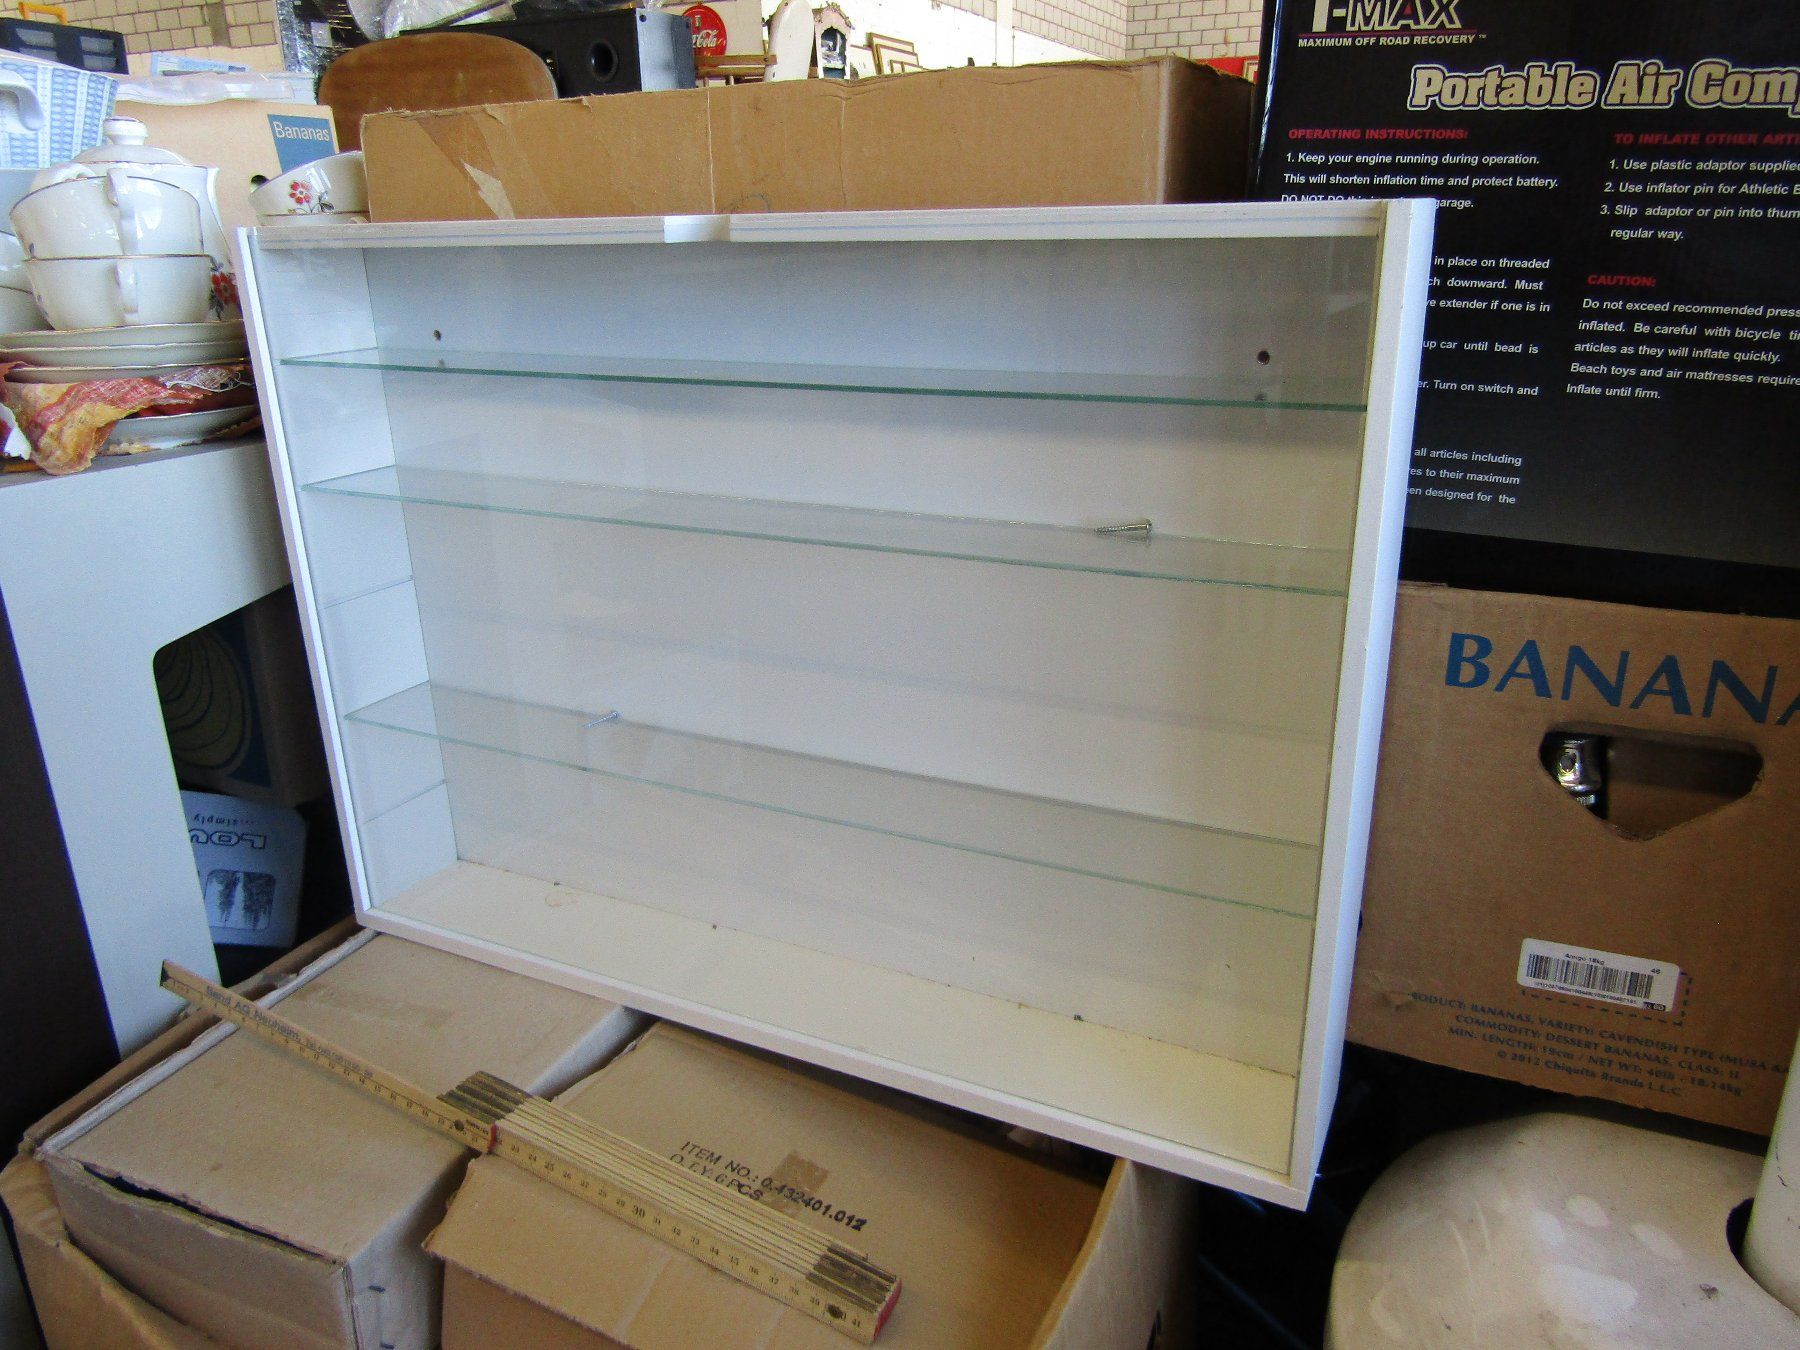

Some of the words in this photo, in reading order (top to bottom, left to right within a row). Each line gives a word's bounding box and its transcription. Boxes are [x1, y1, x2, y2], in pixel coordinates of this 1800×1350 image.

[1299, 38, 1352, 47] MAXIMUM
[1355, 37, 1377, 46] OFF
[1380, 36, 1411, 46] ROAD
[1413, 35, 1475, 45] RECOVERY
[1407, 62, 1600, 110] Portable
[1601, 59, 1684, 109] Air
[273, 121, 330, 141] Bananas
[1288, 128, 1362, 140] OPERATING
[1364, 128, 1468, 140] INSTRUCTIONS:
[1614, 132, 1635, 145] TO
[1638, 132, 1701, 145] INFLATE
[1704, 133, 1759, 145] OTHER
[1286, 152, 1295, 163] 1.
[1297, 152, 1326, 165] Keep
[1327, 154, 1354, 165] your
[1355, 152, 1393, 166] engine
[1395, 153, 1439, 166] running
[1441, 153, 1479, 167] during
[1481, 153, 1540, 167] operation.
[1609, 158, 1619, 170] 1.
[1623, 159, 1648, 170] Use
[1649, 159, 1693, 173] plastic
[1695, 159, 1747, 173] adaptor
[1283, 173, 1306, 184] This
[1308, 173, 1327, 184] will
[1329, 174, 1370, 185] shorten
[1373, 174, 1417, 186] inflation
[1420, 175, 1445, 186] time
[1447, 175, 1470, 186] and
[1471, 176, 1514, 189] protect
[1515, 175, 1558, 190] battery.
[1603, 181, 1615, 193] 2.
[1618, 181, 1643, 193] Use
[1645, 182, 1692, 194] inflator
[1692, 185, 1715, 196] pin
[1717, 182, 1737, 194] for
[1738, 183, 1789, 195] Athletic
[1599, 204, 1610, 215] 3.
[1614, 204, 1639, 218] Slip
[1644, 205, 1694, 219] adaptor
[1696, 208, 1712, 217] or
[1713, 206, 1735, 220] pin
[1737, 206, 1764, 218] into
[1610, 227, 1655, 241] regular
[1657, 230, 1684, 242] way.
[1434, 255, 1445, 266] in
[1447, 256, 1478, 268] place
[1480, 259, 1496, 267] on
[1498, 257, 1551, 269] threaded
[1446, 277, 1508, 289] downward.
[1514, 279, 1544, 291] Must
[1586, 274, 1657, 287] CAUTION:
[1439, 298, 1489, 310] extender
[1490, 299, 1500, 310] if
[1500, 302, 1523, 311] one
[1525, 301, 1536, 312] is
[1539, 301, 1551, 312] in
[1582, 298, 1600, 309] Do
[1602, 300, 1624, 310] not
[1625, 301, 1670, 312] exceed
[1672, 304, 1764, 316] recommended
[1578, 319, 1626, 332] inflated.
[1633, 322, 1651, 334] Be
[1653, 324, 1698, 336] careful
[1704, 326, 1731, 337] with
[1734, 327, 1782, 341] bicycle
[1439, 341, 1458, 350] car
[1463, 341, 1489, 351] until
[1494, 342, 1523, 353] bead
[1528, 343, 1539, 354] is
[1574, 342, 1617, 354] articles
[1619, 346, 1635, 355] as
[1638, 344, 1665, 358] they
[1667, 346, 1689, 357] will
[1691, 347, 1730, 360] inflate
[1733, 350, 1781, 365] quickly.
[1570, 362, 1608, 374] Beach
[1610, 365, 1637, 378] toys
[1639, 367, 1664, 378] and
[1665, 368, 1683, 379] air
[1685, 370, 1754, 383] mattresses
[1433, 379, 1458, 391] Turn
[1460, 383, 1475, 392] on
[1477, 383, 1514, 394] switch
[1516, 386, 1539, 396] and
[1566, 383, 1602, 395] Inflate
[1605, 386, 1632, 397] until
[1634, 387, 1661, 399] firm.
[1413, 447, 1428, 457] all
[1429, 449, 1469, 461] articles
[1471, 451, 1522, 467] including
[1425, 467, 1437, 477] to
[1439, 469, 1465, 480] their
[1466, 472, 1521, 485] maximum
[1424, 487, 1475, 501] designed
[1476, 491, 1493, 502] for
[1498, 494, 1516, 504] the
[1408, 992, 1466, 1010] RODUCT:
[1600, 1030, 1679, 1053] CAVENDISH
[1684, 1046, 1714, 1060] TYPE
[1546, 1032, 1600, 1051] DESSERT
[1588, 1054, 1613, 1069] NET
[680, 1141, 722, 1165] ITEM
